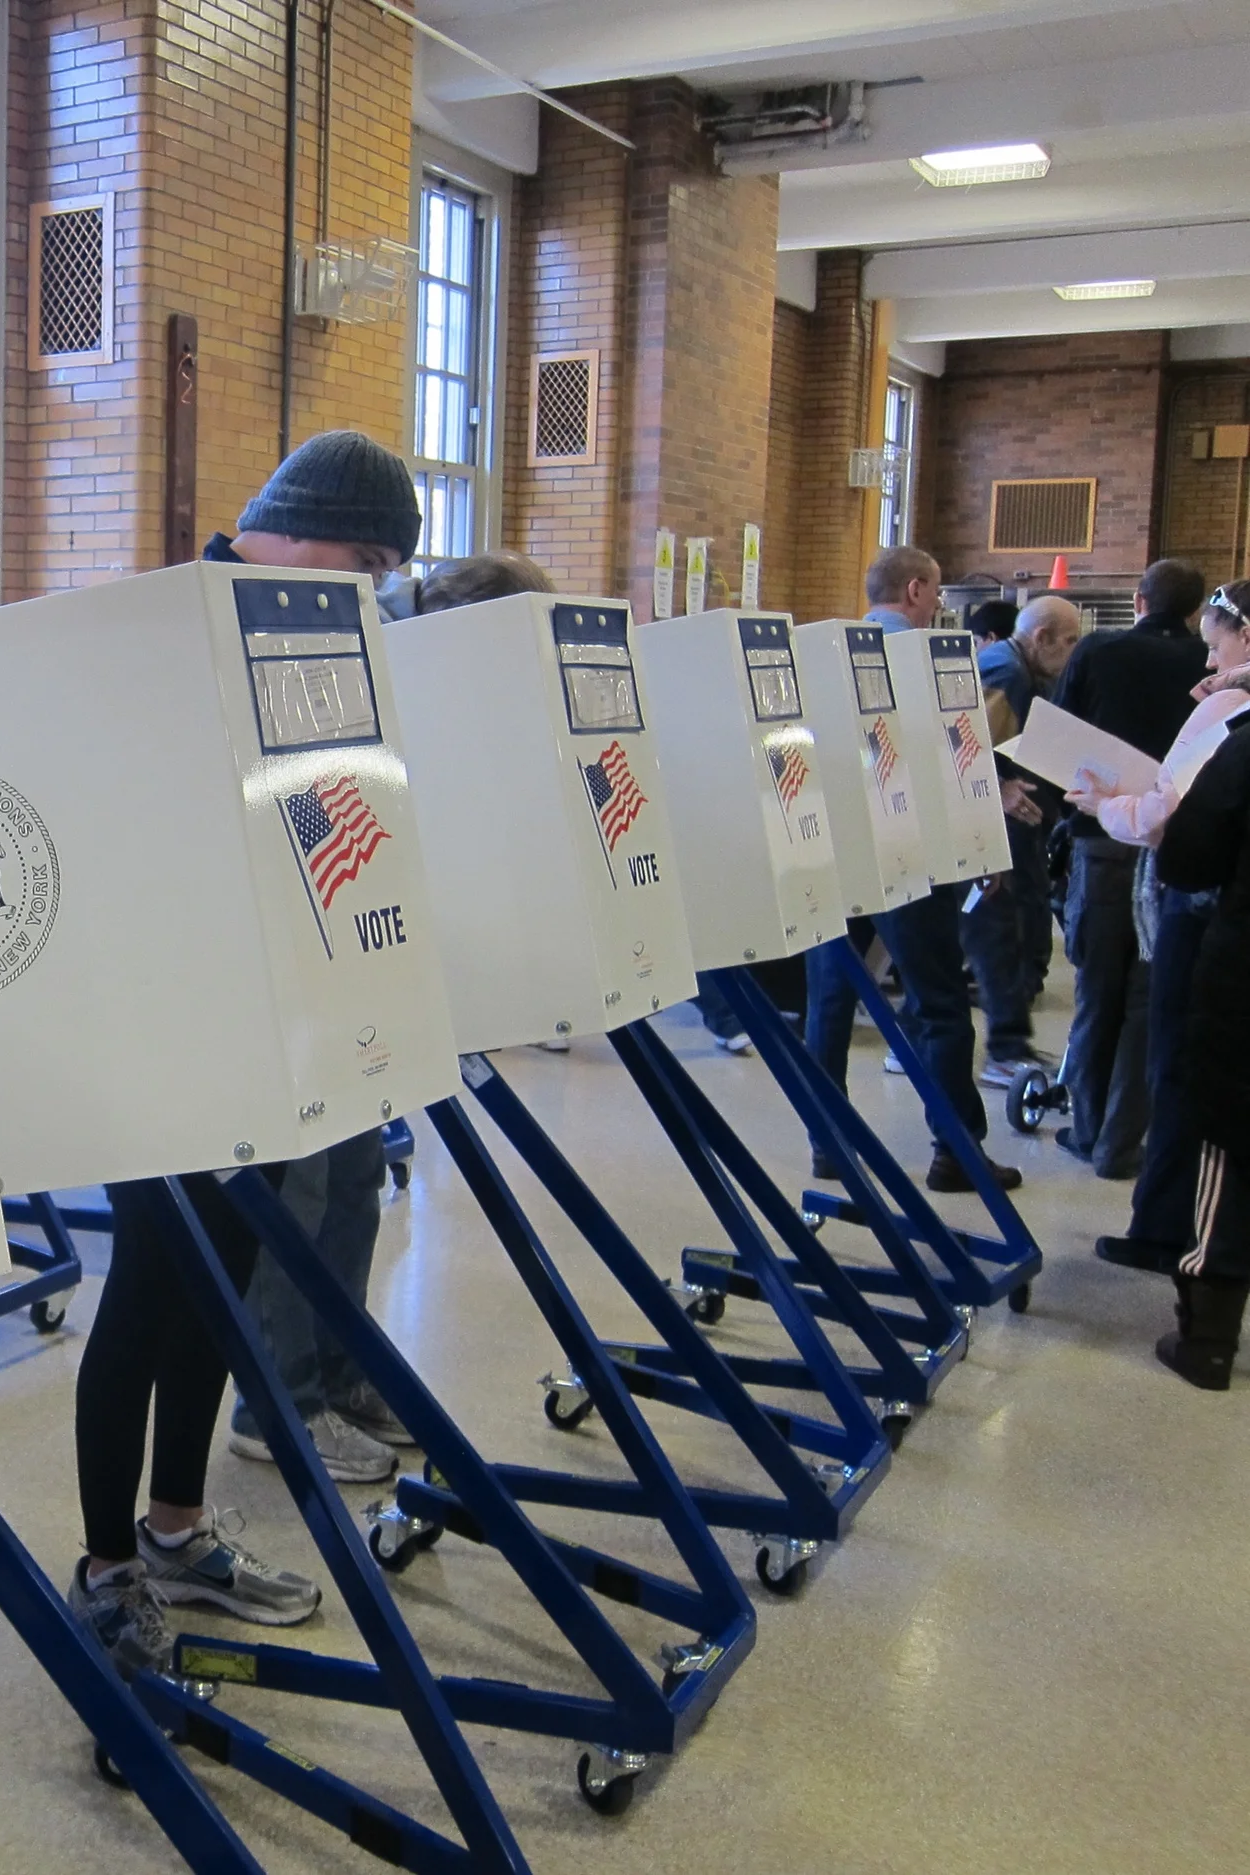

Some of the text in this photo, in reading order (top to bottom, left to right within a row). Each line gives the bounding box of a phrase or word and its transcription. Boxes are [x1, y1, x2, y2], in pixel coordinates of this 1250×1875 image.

[891, 791, 908, 815] VOTE
[971, 779, 990, 799] VOTE
[798, 813, 820, 841] VOTE
[628, 853, 659, 887] VOTE
[25, 863, 49, 927] YORK
[353, 904, 407, 953] VOTE
